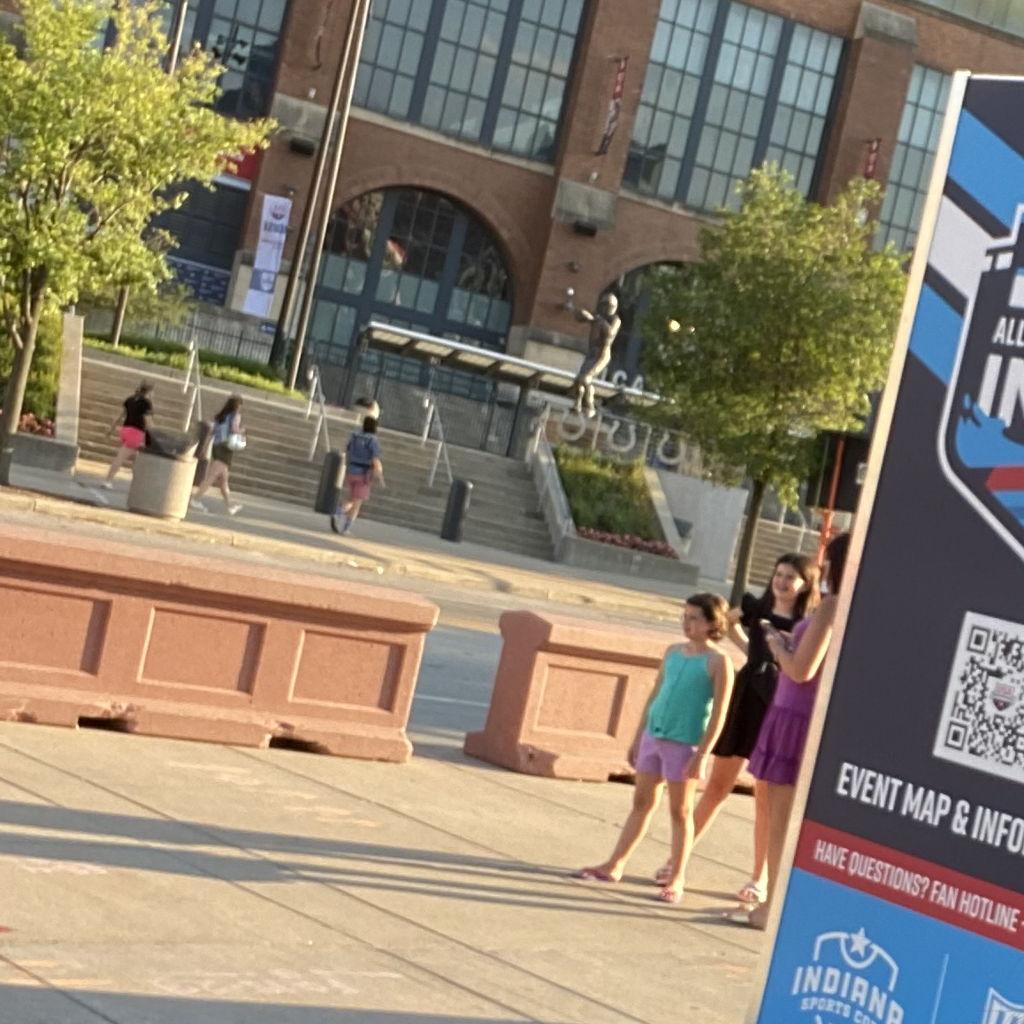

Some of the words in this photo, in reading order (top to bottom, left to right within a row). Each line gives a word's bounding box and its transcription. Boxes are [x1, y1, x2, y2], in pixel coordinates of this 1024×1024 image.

[836, 762, 903, 810] EVENT
[902, 782, 952, 827] MAP
[952, 799, 970, 834] &
[814, 839, 849, 869] HAVE
[848, 851, 929, 899] QUESTIONS?
[930, 880, 960, 911] FAN
[959, 891, 1020, 932] HOTLINE
[800, 997, 851, 1018] SPORTS
